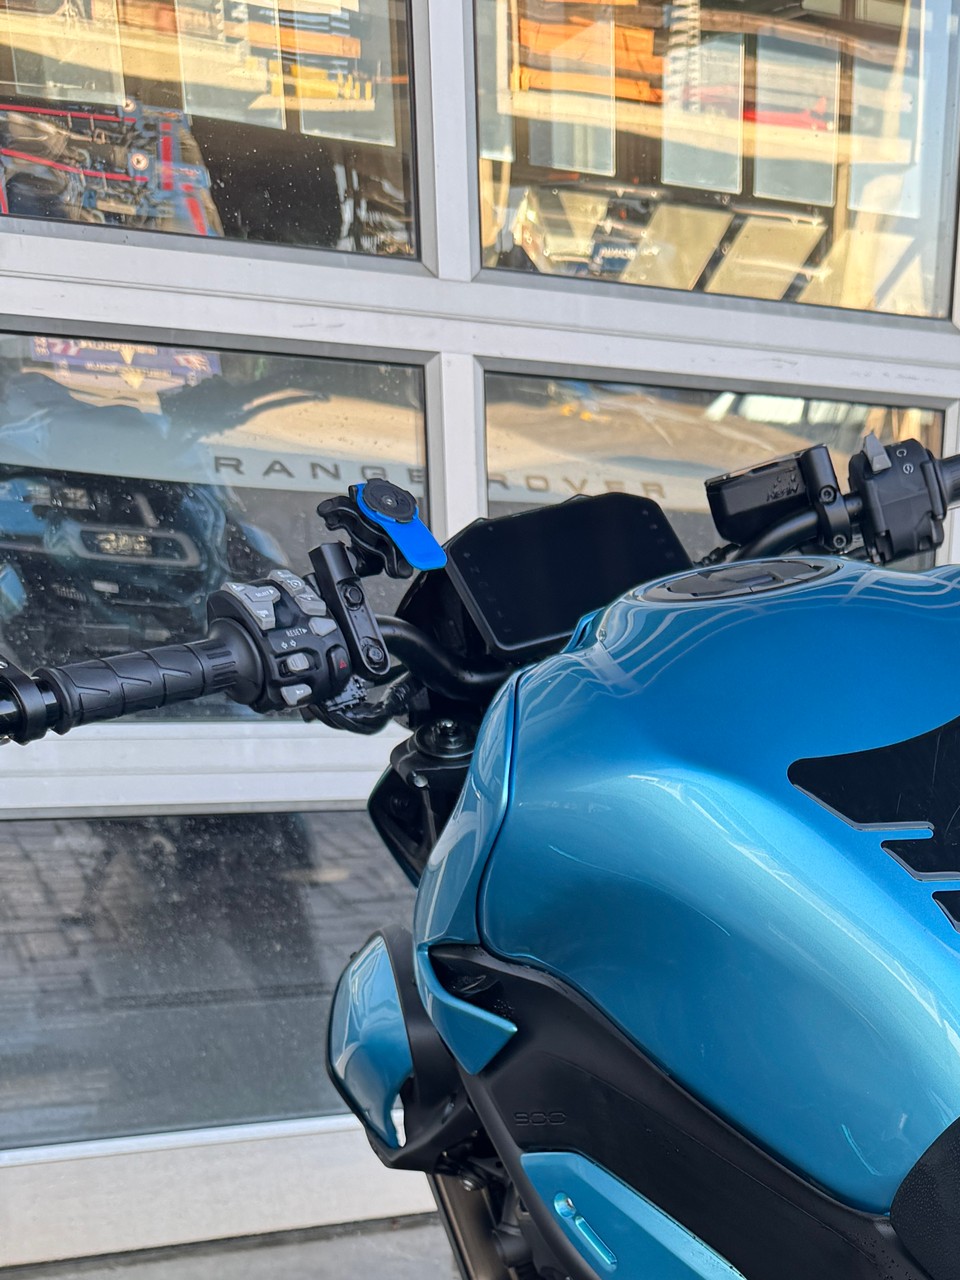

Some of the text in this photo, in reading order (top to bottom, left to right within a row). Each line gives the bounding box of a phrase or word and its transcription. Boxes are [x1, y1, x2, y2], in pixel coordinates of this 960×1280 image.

[214, 455, 426, 484] RANGE
[286, 628, 303, 637] RESET
[514, 1111, 567, 1126] 900
